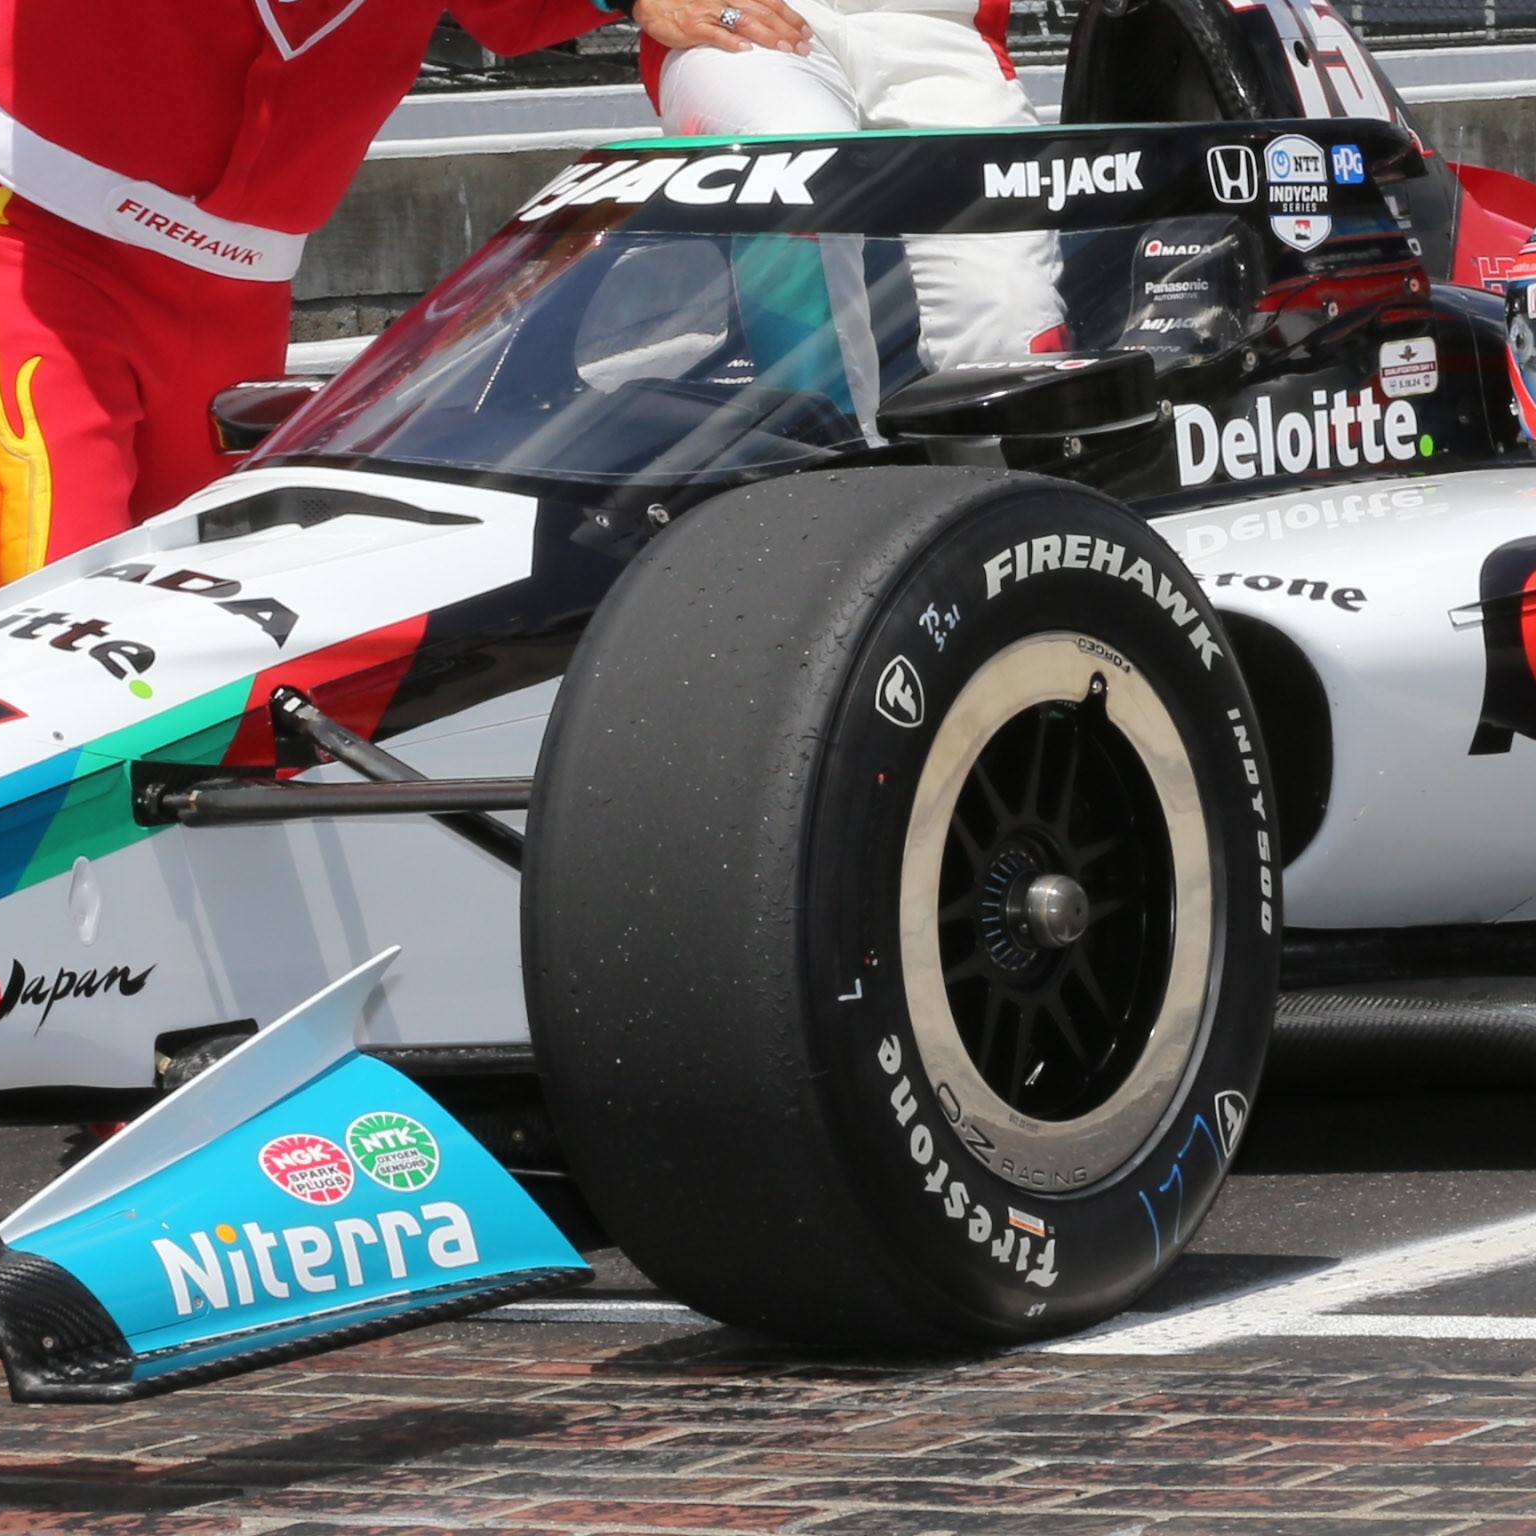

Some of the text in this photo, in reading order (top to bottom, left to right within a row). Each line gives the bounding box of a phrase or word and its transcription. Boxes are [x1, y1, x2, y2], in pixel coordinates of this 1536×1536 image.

[1293, 155, 1322, 174] NTT
[1332, 147, 1362, 184] PPG
[983, 151, 1144, 212] MI-JACK
[1269, 185, 1328, 204] INDYCAR
[1282, 203, 1317, 213] SERIES
[115, 198, 263, 267] FIREHAWK
[1145, 277, 1209, 296] Panasonic
[1153, 292, 1199, 302] AUTOMOTIVE
[84, 561, 301, 650] ADA
[982, 533, 1225, 671] FIREHAWK
[1076, 636, 1132, 674] FORGED
[1226, 707, 1273, 936] INDY 500
[359, 1126, 417, 1153] NTK
[271, 1144, 332, 1171] NGK
[377, 1148, 419, 1164] OXYGEN
[379, 1159, 427, 1175] SENSORS
[878, 1034, 1059, 1288] Firestone
[289, 1164, 339, 1184] SPARK
[296, 1175, 345, 1193] PLUGS
[1001, 1157, 1088, 1187] RACING
[152, 1201, 480, 1316] Niterra
